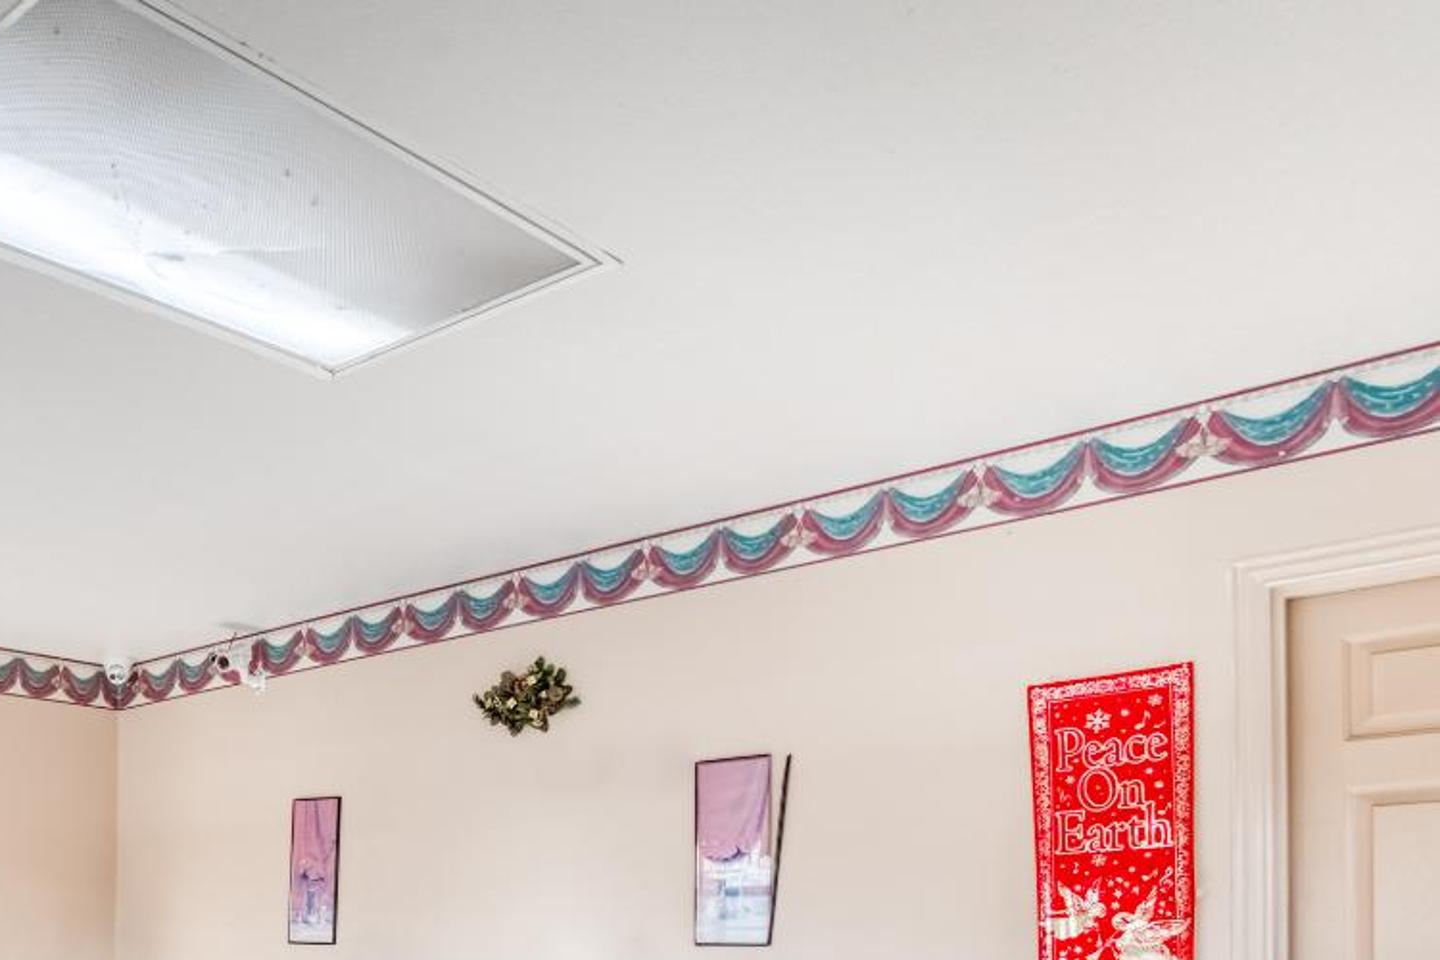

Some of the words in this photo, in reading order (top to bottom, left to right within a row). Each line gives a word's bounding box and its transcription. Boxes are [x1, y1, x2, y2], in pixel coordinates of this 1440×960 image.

[1055, 727, 1168, 772] Peace
[1077, 768, 1146, 812] On
[1055, 800, 1174, 854] Earth
